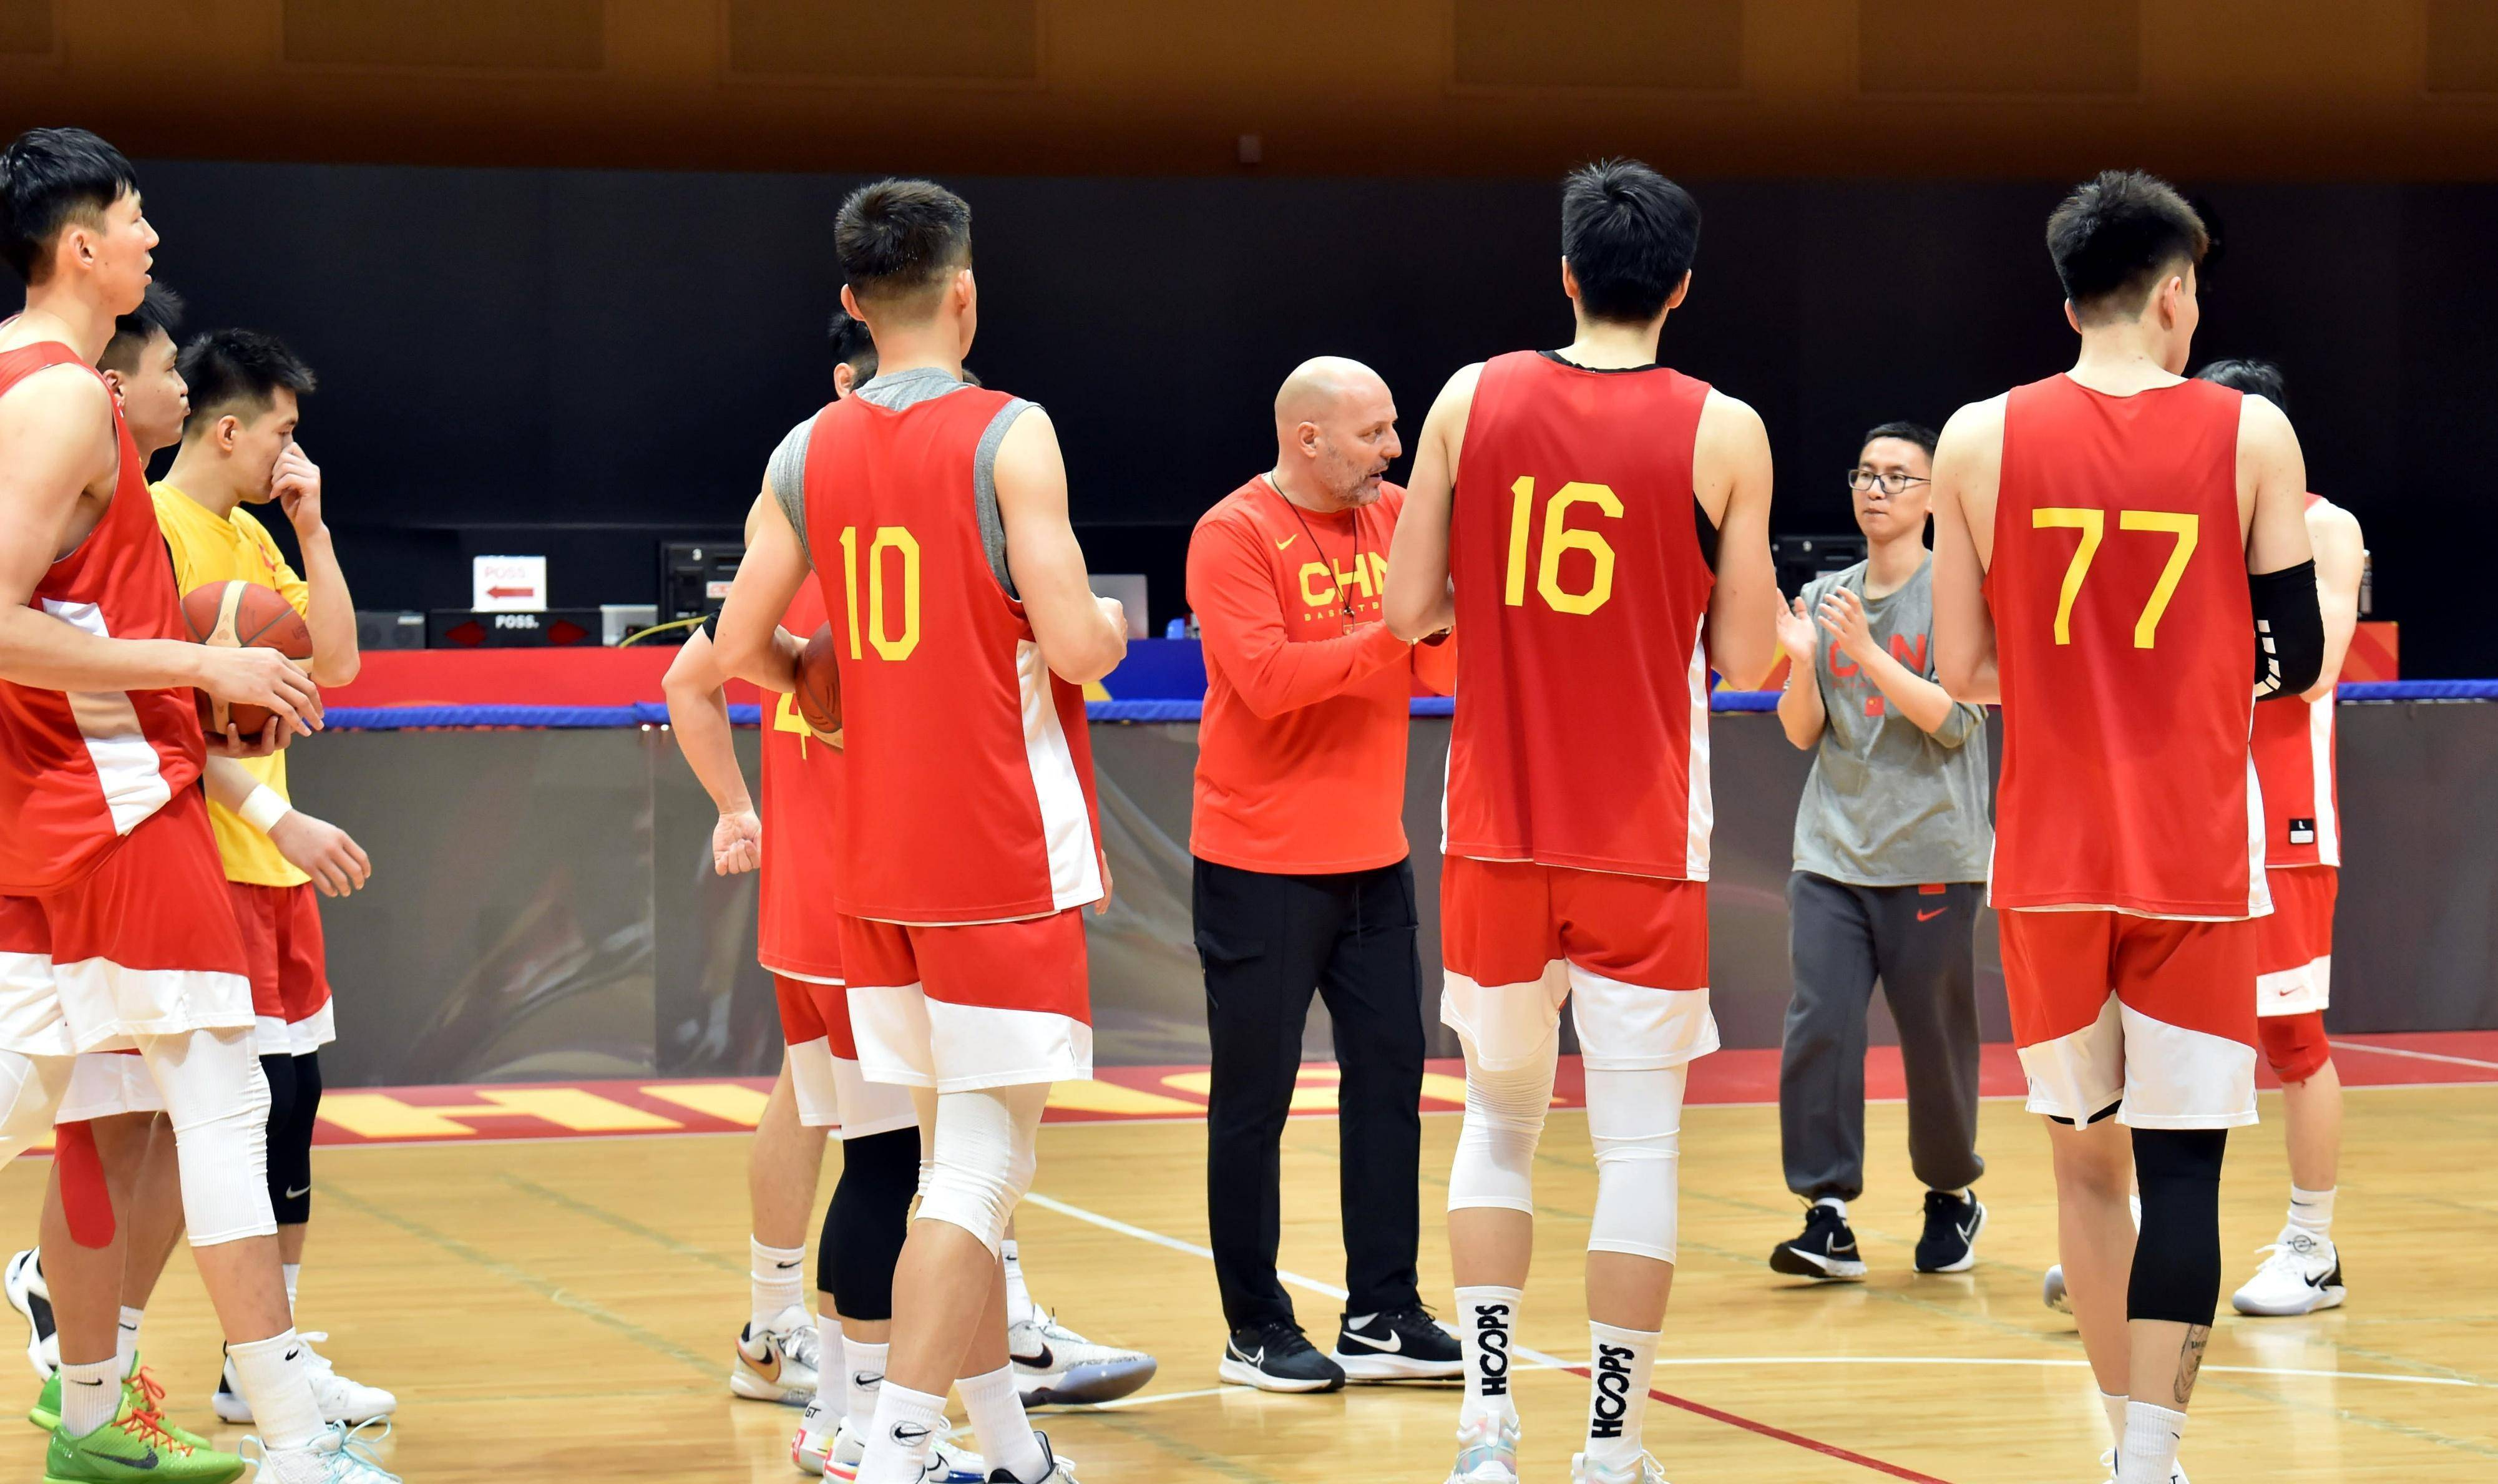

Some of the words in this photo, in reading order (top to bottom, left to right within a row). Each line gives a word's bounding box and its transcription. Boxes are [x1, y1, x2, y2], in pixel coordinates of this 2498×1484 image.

[838, 526, 920, 661] 10
[1504, 475, 1624, 616] 16
[2032, 507, 2199, 649] 77
[1829, 633, 1926, 677] CN
[1475, 1304, 1510, 1397] HOOPS
[1591, 1343, 1635, 1438] HOOPS
